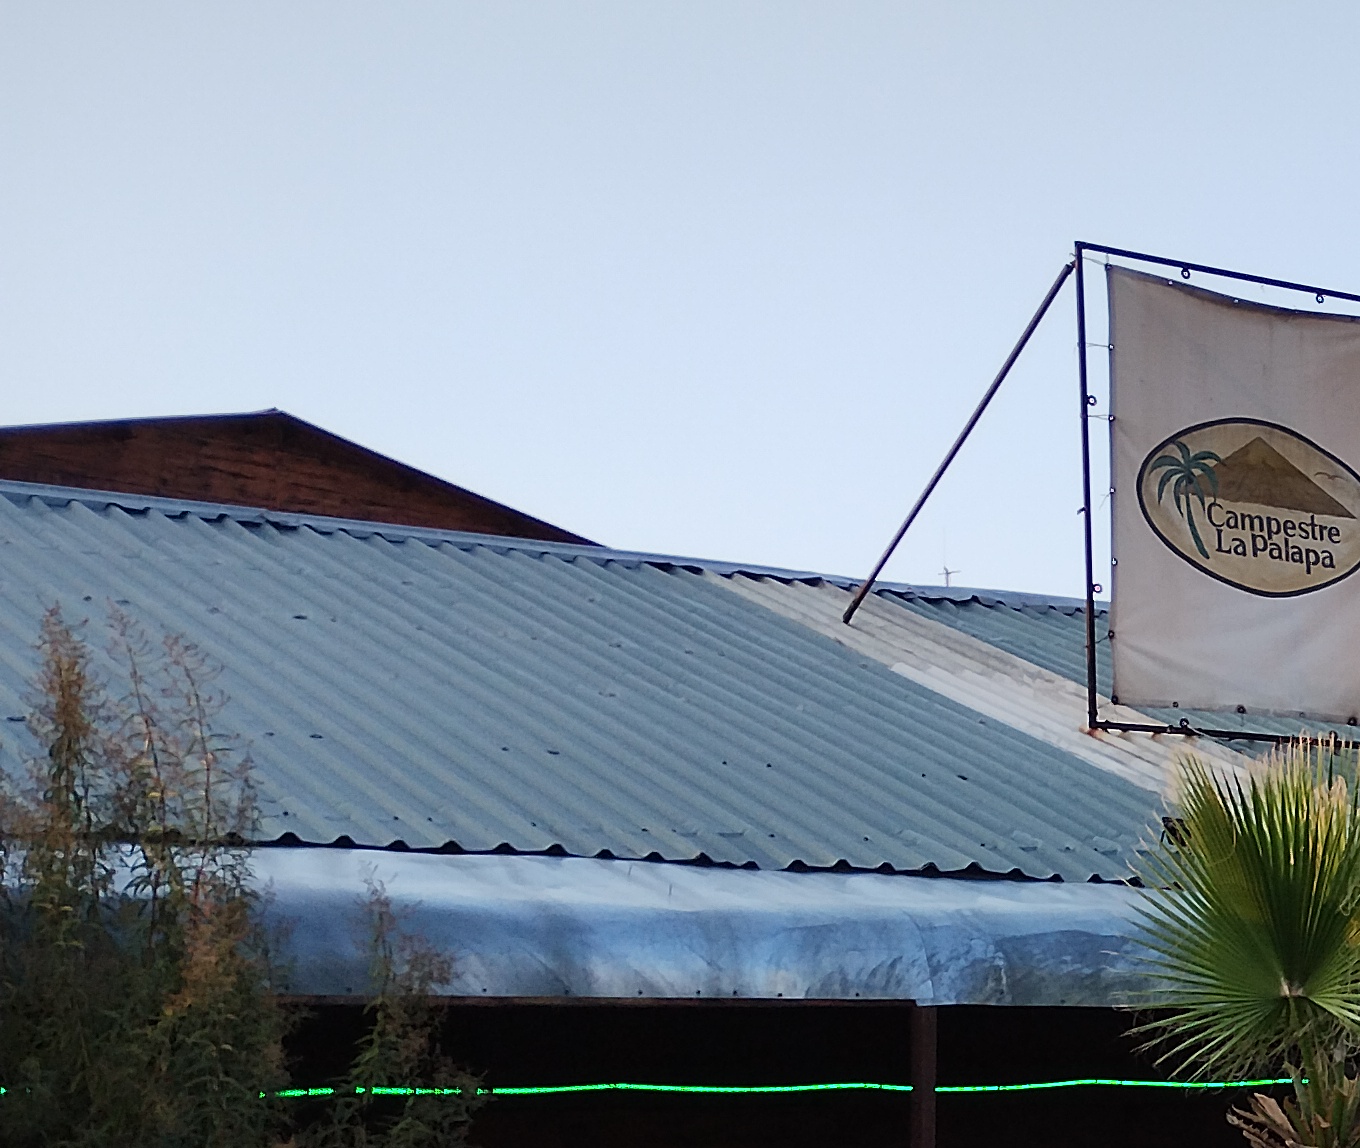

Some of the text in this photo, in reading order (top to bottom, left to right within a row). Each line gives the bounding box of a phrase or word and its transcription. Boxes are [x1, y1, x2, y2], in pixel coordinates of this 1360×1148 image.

[1207, 502, 1341, 544] Campestre
[1215, 528, 1336, 575] La Palapa
